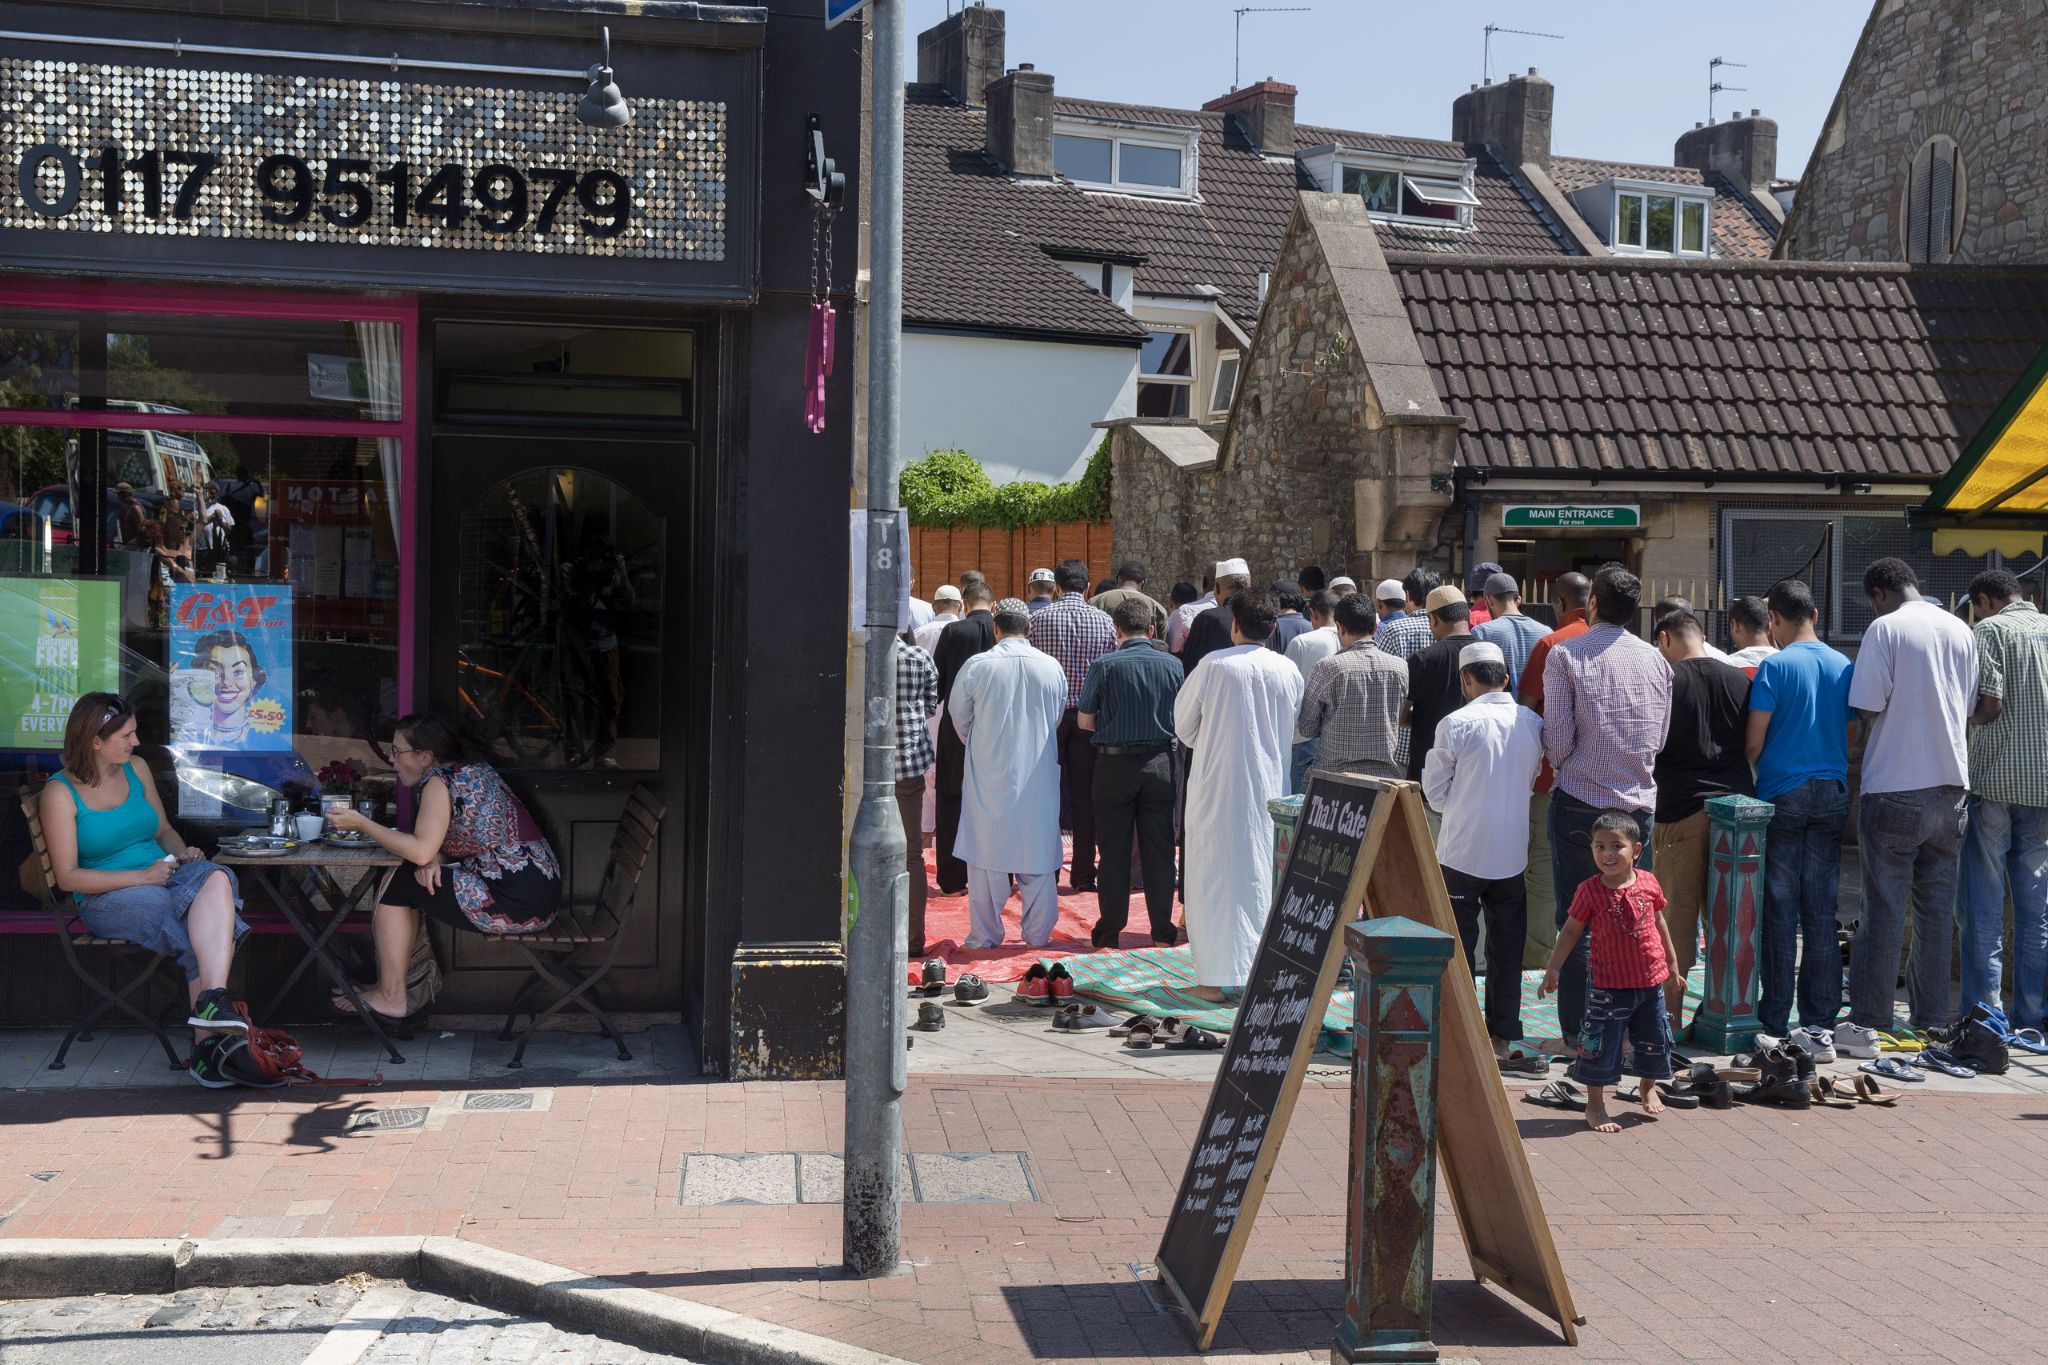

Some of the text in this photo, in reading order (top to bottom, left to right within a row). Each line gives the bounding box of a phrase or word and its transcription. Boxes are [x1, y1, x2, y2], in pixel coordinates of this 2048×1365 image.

[18, 143, 631, 238] 0117 9514979
[1529, 510, 1614, 518] MAIN ENTRANCE
[877, 548, 892, 569] 8
[35, 647, 78, 667] FREE
[1308, 795, 1366, 838] Thali Cafe
[1244, 994, 1279, 1036] Loyalty
